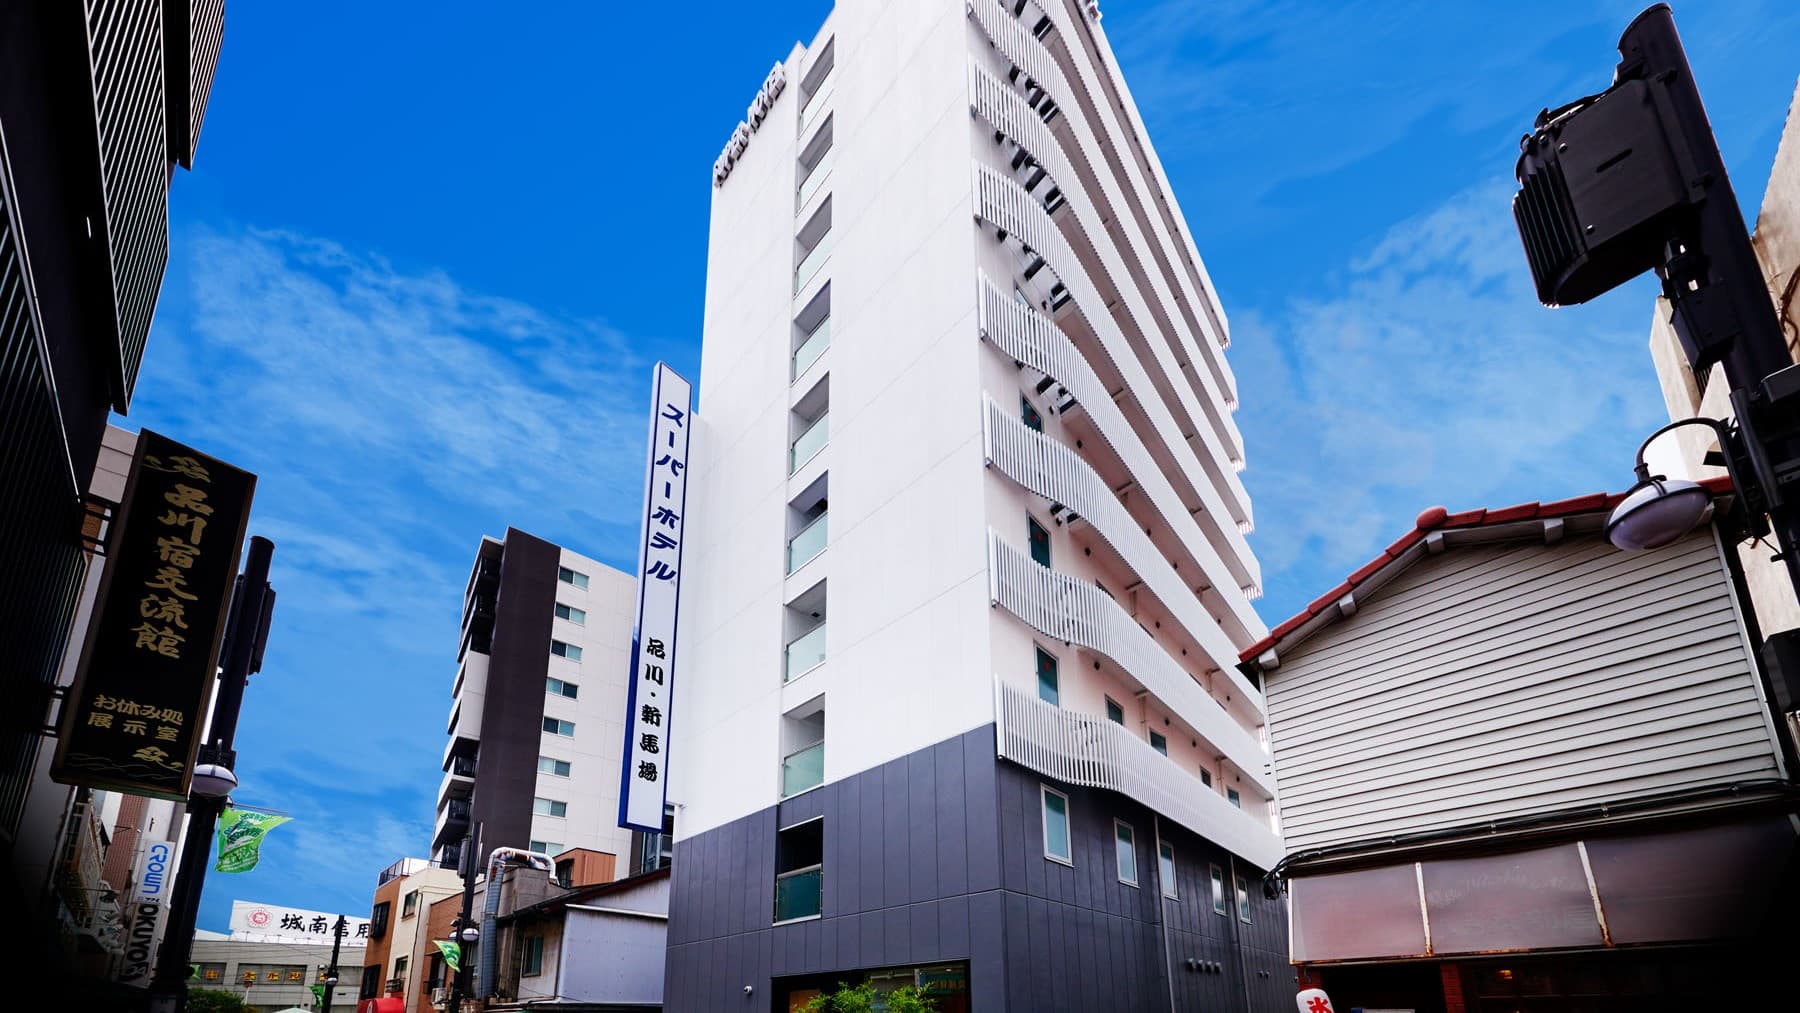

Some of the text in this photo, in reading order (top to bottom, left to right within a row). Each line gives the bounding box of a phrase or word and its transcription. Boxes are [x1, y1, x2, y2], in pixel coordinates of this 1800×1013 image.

[647, 403, 685, 581] スーパーホテル
[131, 483, 214, 659] 品川宿交流館
[87, 711, 179, 742] 展示室
[93, 694, 184, 726] お休み処
[638, 637, 666, 782] 品川・新馬場
